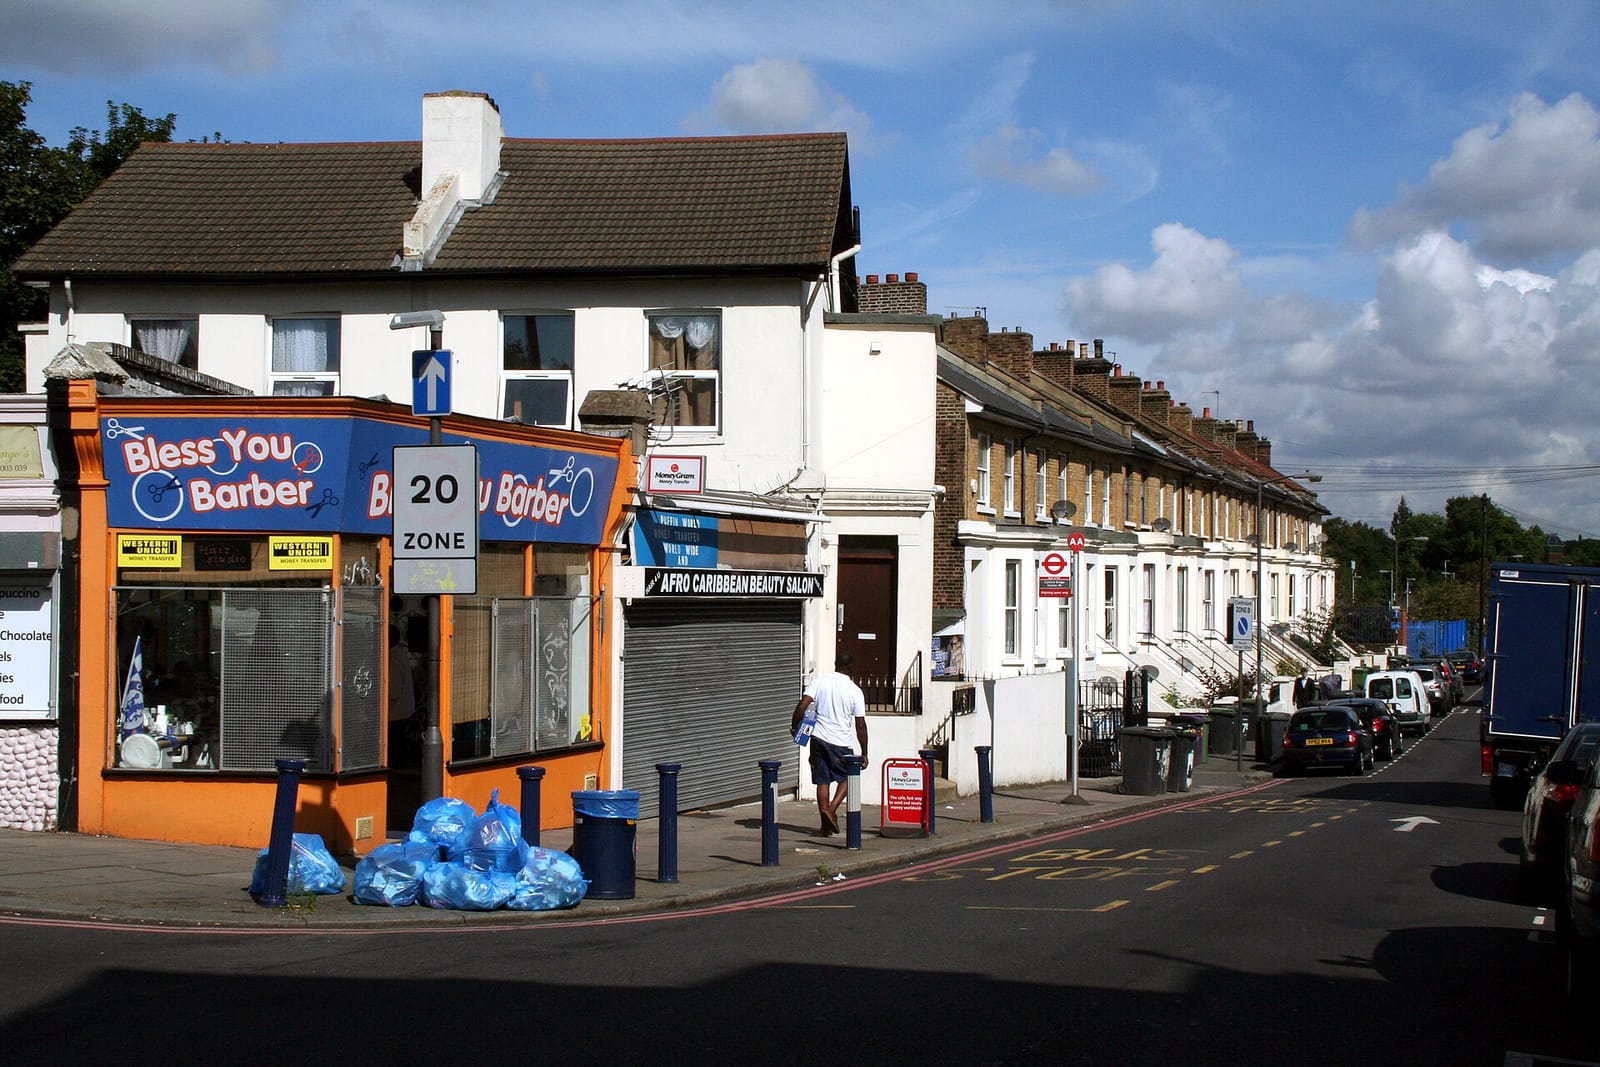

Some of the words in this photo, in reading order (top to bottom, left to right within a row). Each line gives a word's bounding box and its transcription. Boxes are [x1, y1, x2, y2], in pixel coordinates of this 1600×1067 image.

[123, 437, 215, 473] Bless
[222, 429, 292, 462] You
[14, 464, 28, 472] 039
[655, 472, 695, 480] MoneyGram
[190, 474, 312, 511] Barber
[410, 474, 458, 504] 20
[497, 473, 568, 526] Barber
[123, 540, 168, 548] WESTERN
[404, 532, 465, 550] ZONE
[662, 542, 681, 554] WORLD
[685, 544, 699, 556] WIDE
[677, 555, 689, 566] AND
[660, 572, 690, 593] AFRO
[692, 573, 749, 593] CARIBBEAN
[749, 575, 785, 594] BEAUTY
[786, 576, 814, 594] SALON
[0, 630, 52, 641] Chocolate
[1007, 848, 1208, 863] BUS
[901, 866, 1186, 882] STOP
